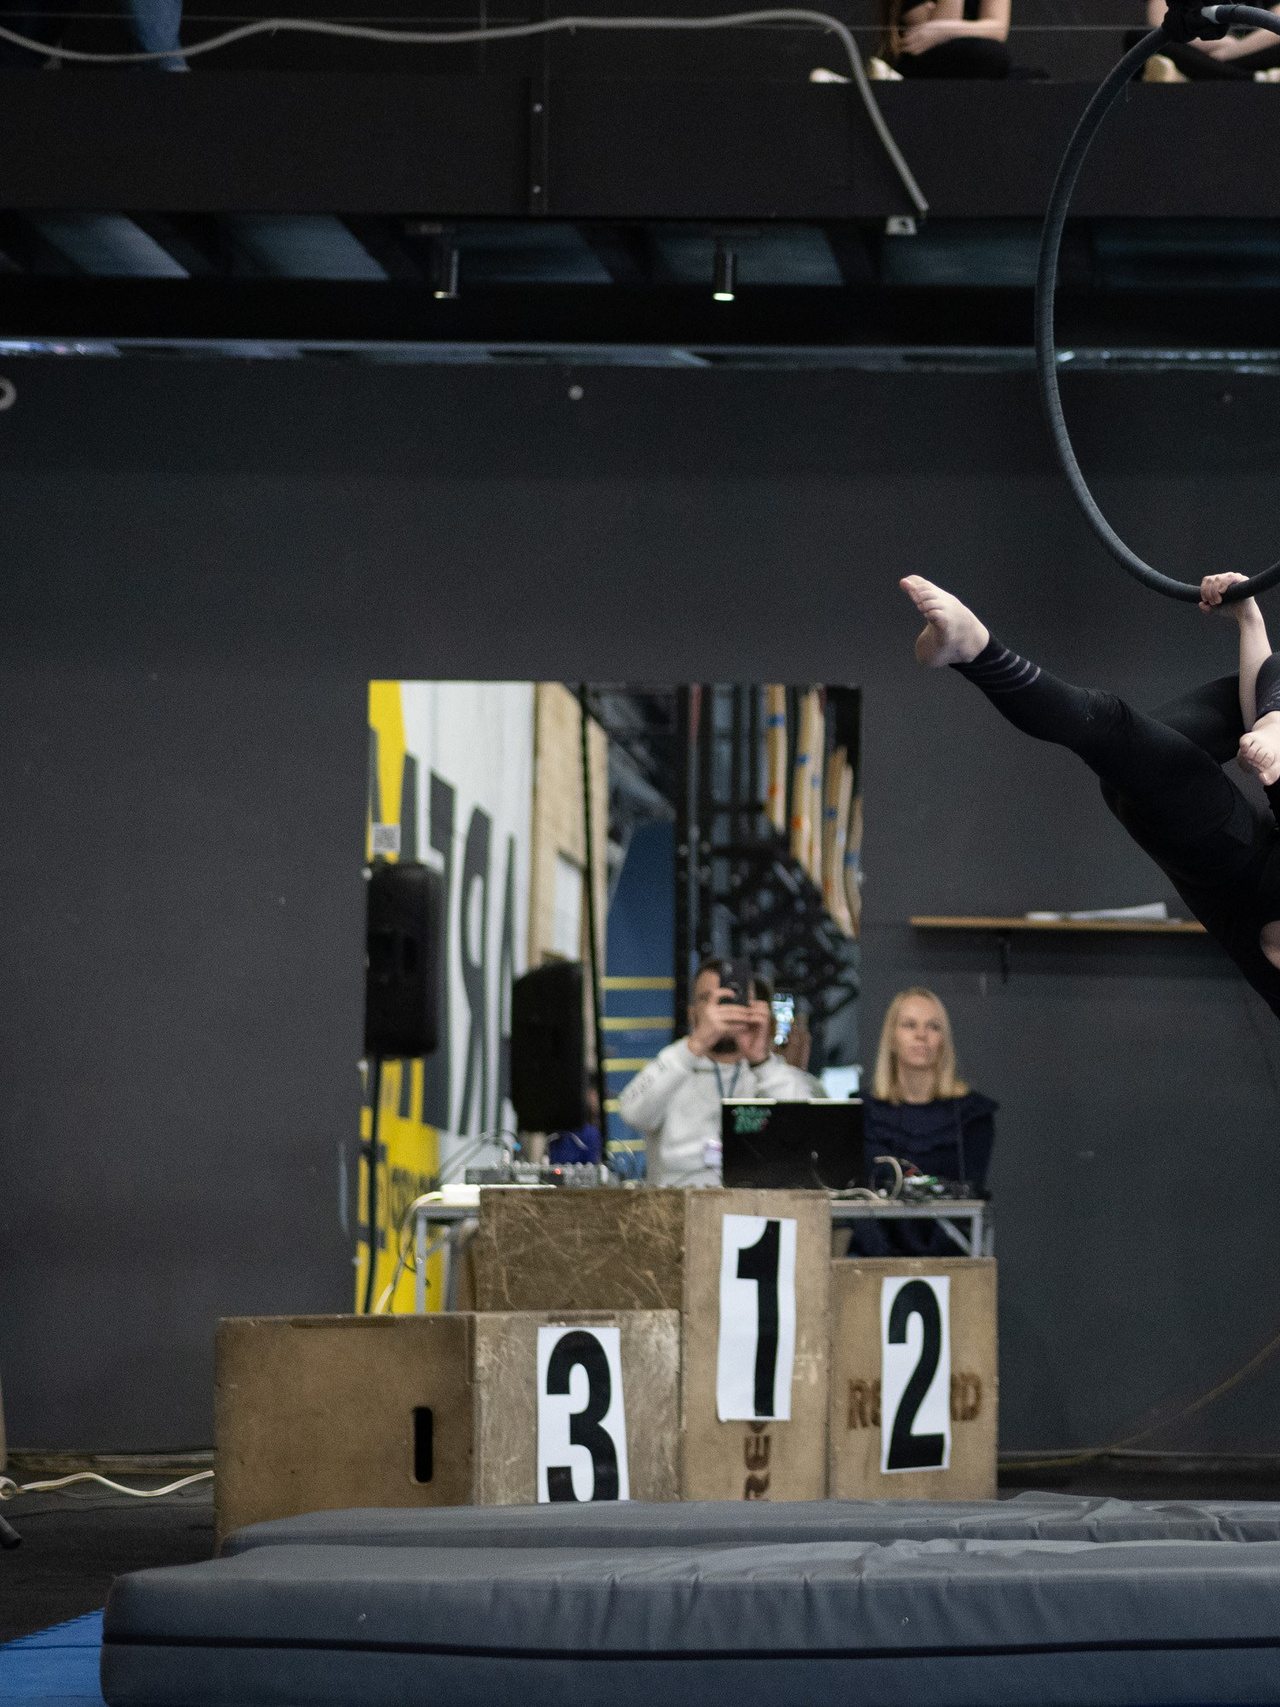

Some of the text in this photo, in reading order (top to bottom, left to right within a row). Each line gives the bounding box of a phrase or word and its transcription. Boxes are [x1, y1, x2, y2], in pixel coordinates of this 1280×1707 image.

[737, 1220, 780, 1417] 1
[887, 1279, 942, 1470] 2
[547, 1330, 619, 1502] 3
